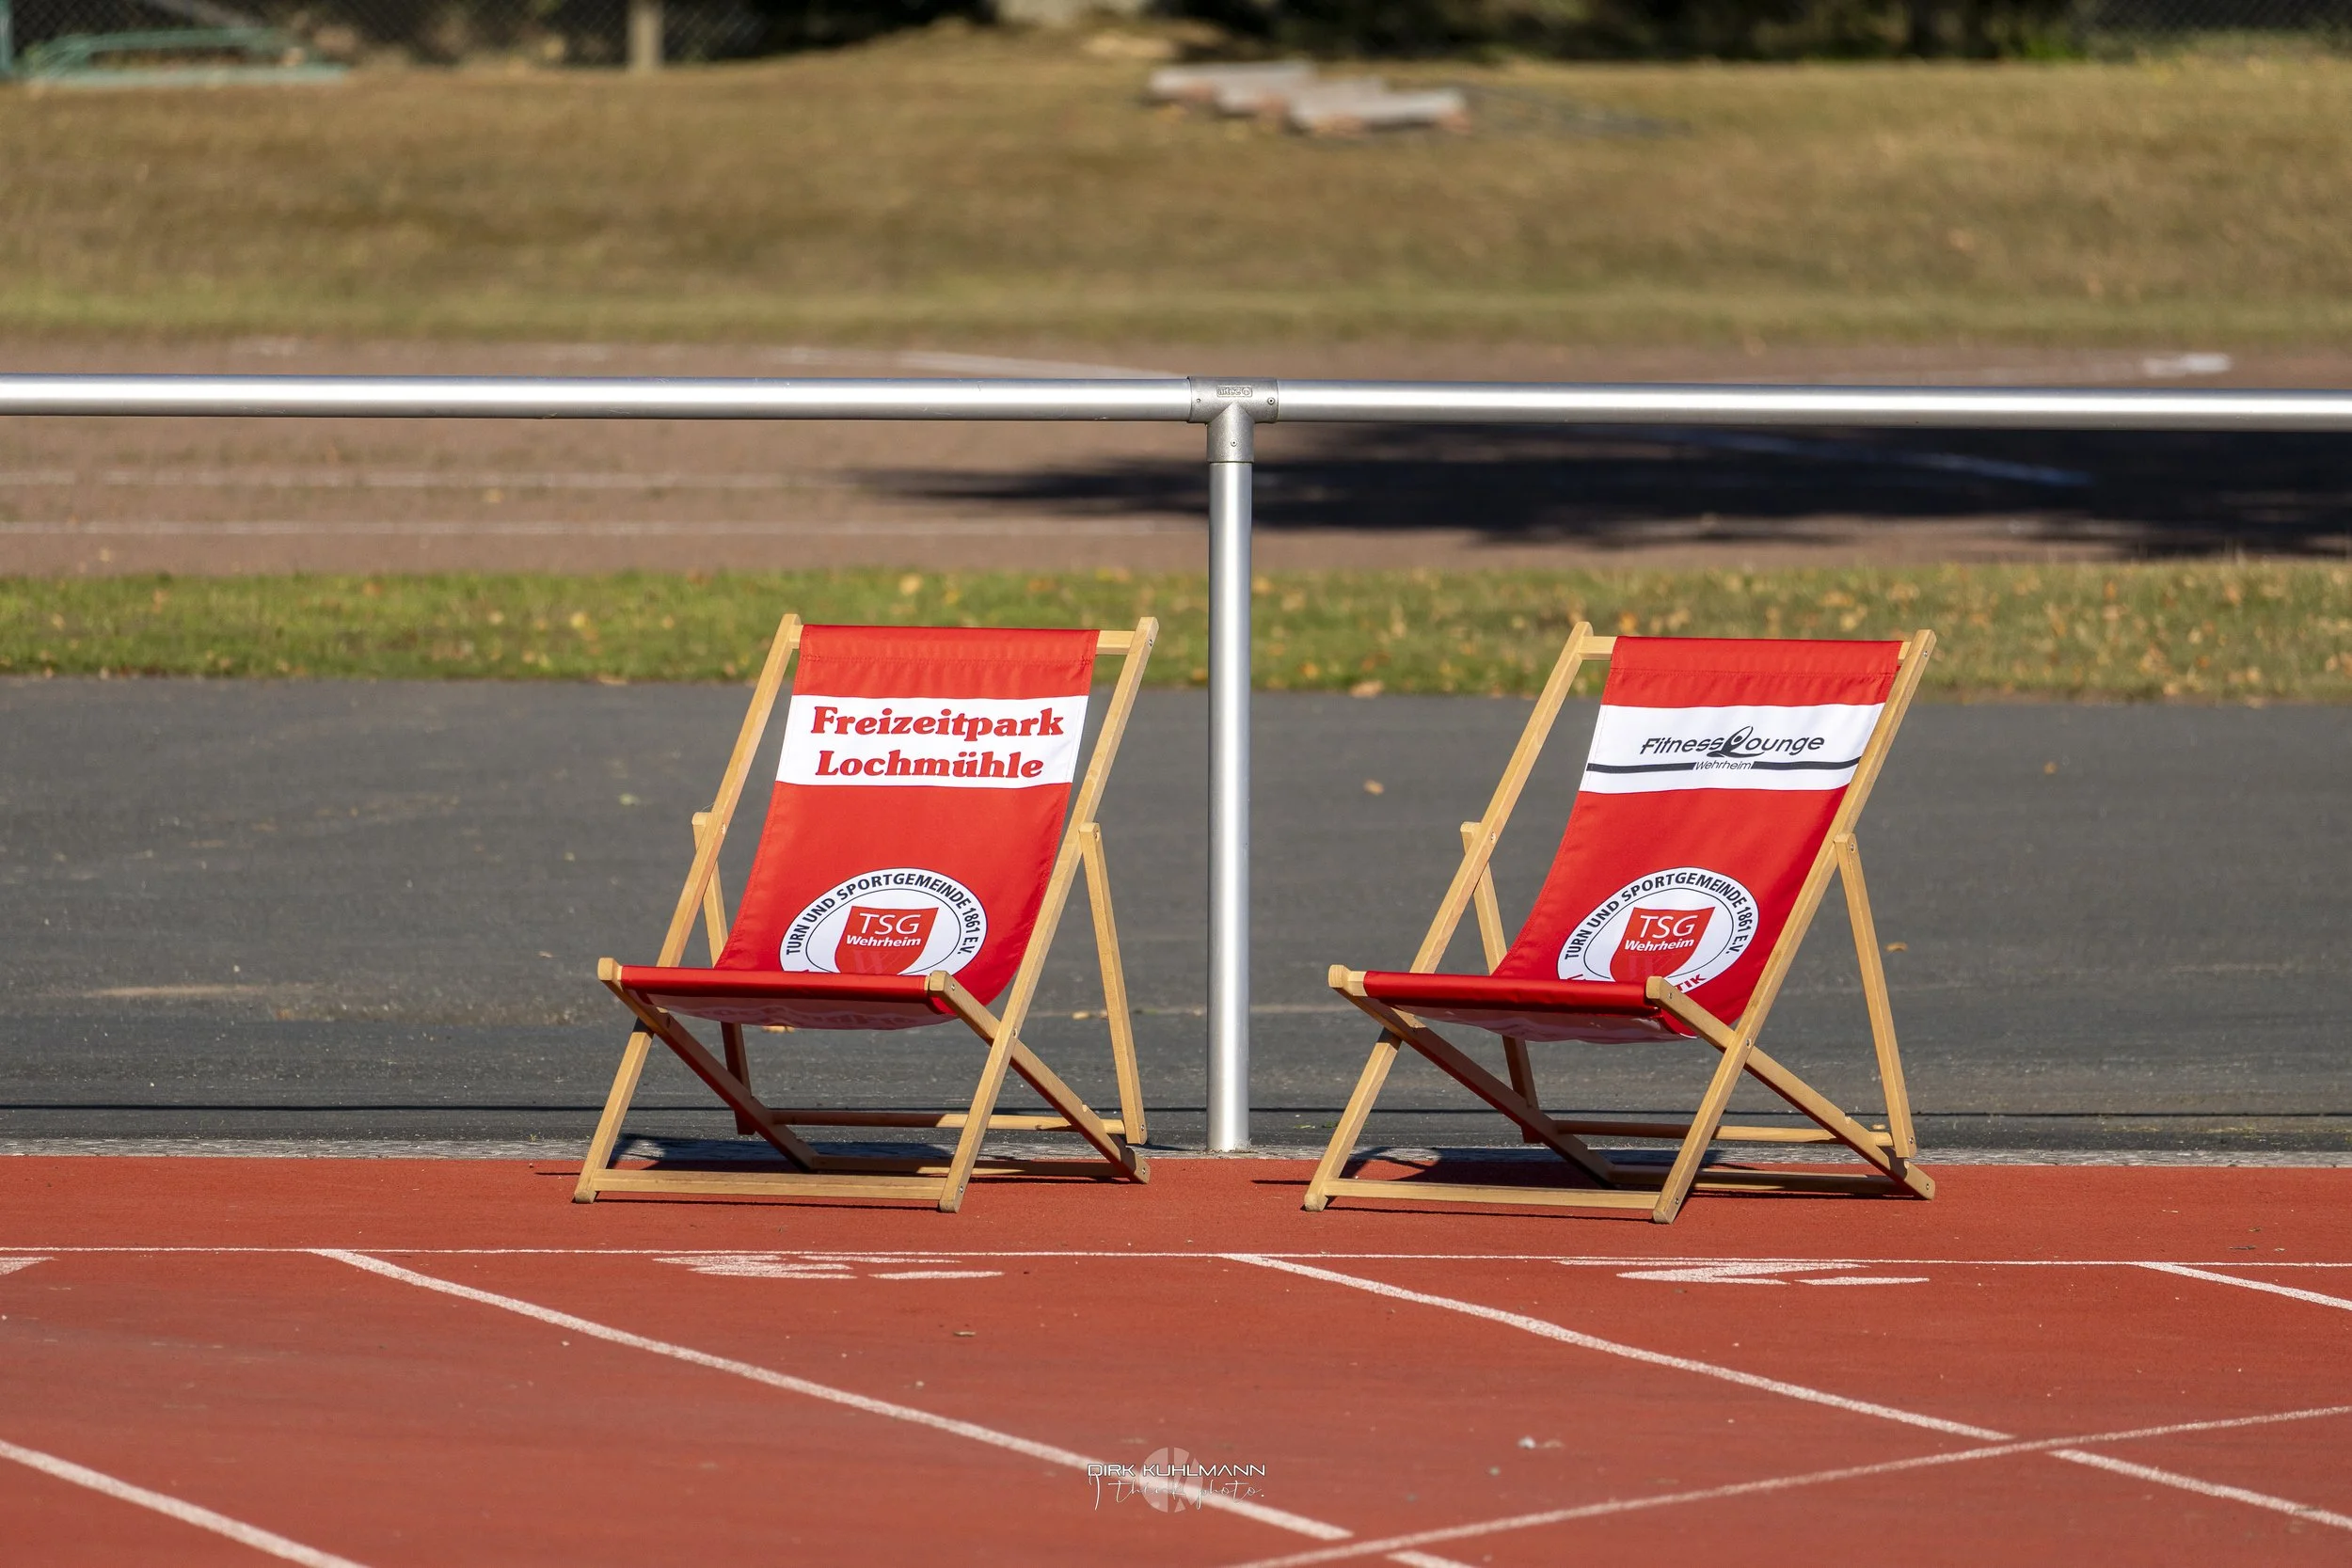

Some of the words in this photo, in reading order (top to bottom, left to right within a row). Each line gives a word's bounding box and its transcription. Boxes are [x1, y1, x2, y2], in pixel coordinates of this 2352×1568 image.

[811, 706, 1064, 741] Freizeitpark
[815, 749, 1044, 778] Lochmühle
[1694, 759, 1752, 771] Wehrheim
[786, 924, 810, 956] TURN
[806, 897, 835, 924] UND
[836, 873, 971, 910] SPORTGEMEINDE
[961, 907, 980, 935] 1861
[859, 912, 921, 935] TSG
[1565, 929, 1592, 960] TURN
[1586, 900, 1620, 929] UND
[1621, 872, 1748, 909] SPORTGEMEINDE
[1737, 906, 1754, 933] 1861
[1640, 914, 1698, 939] TSG
[846, 934, 922, 947] Wehrheim
[1624, 938, 1695, 952] Wehrheim
